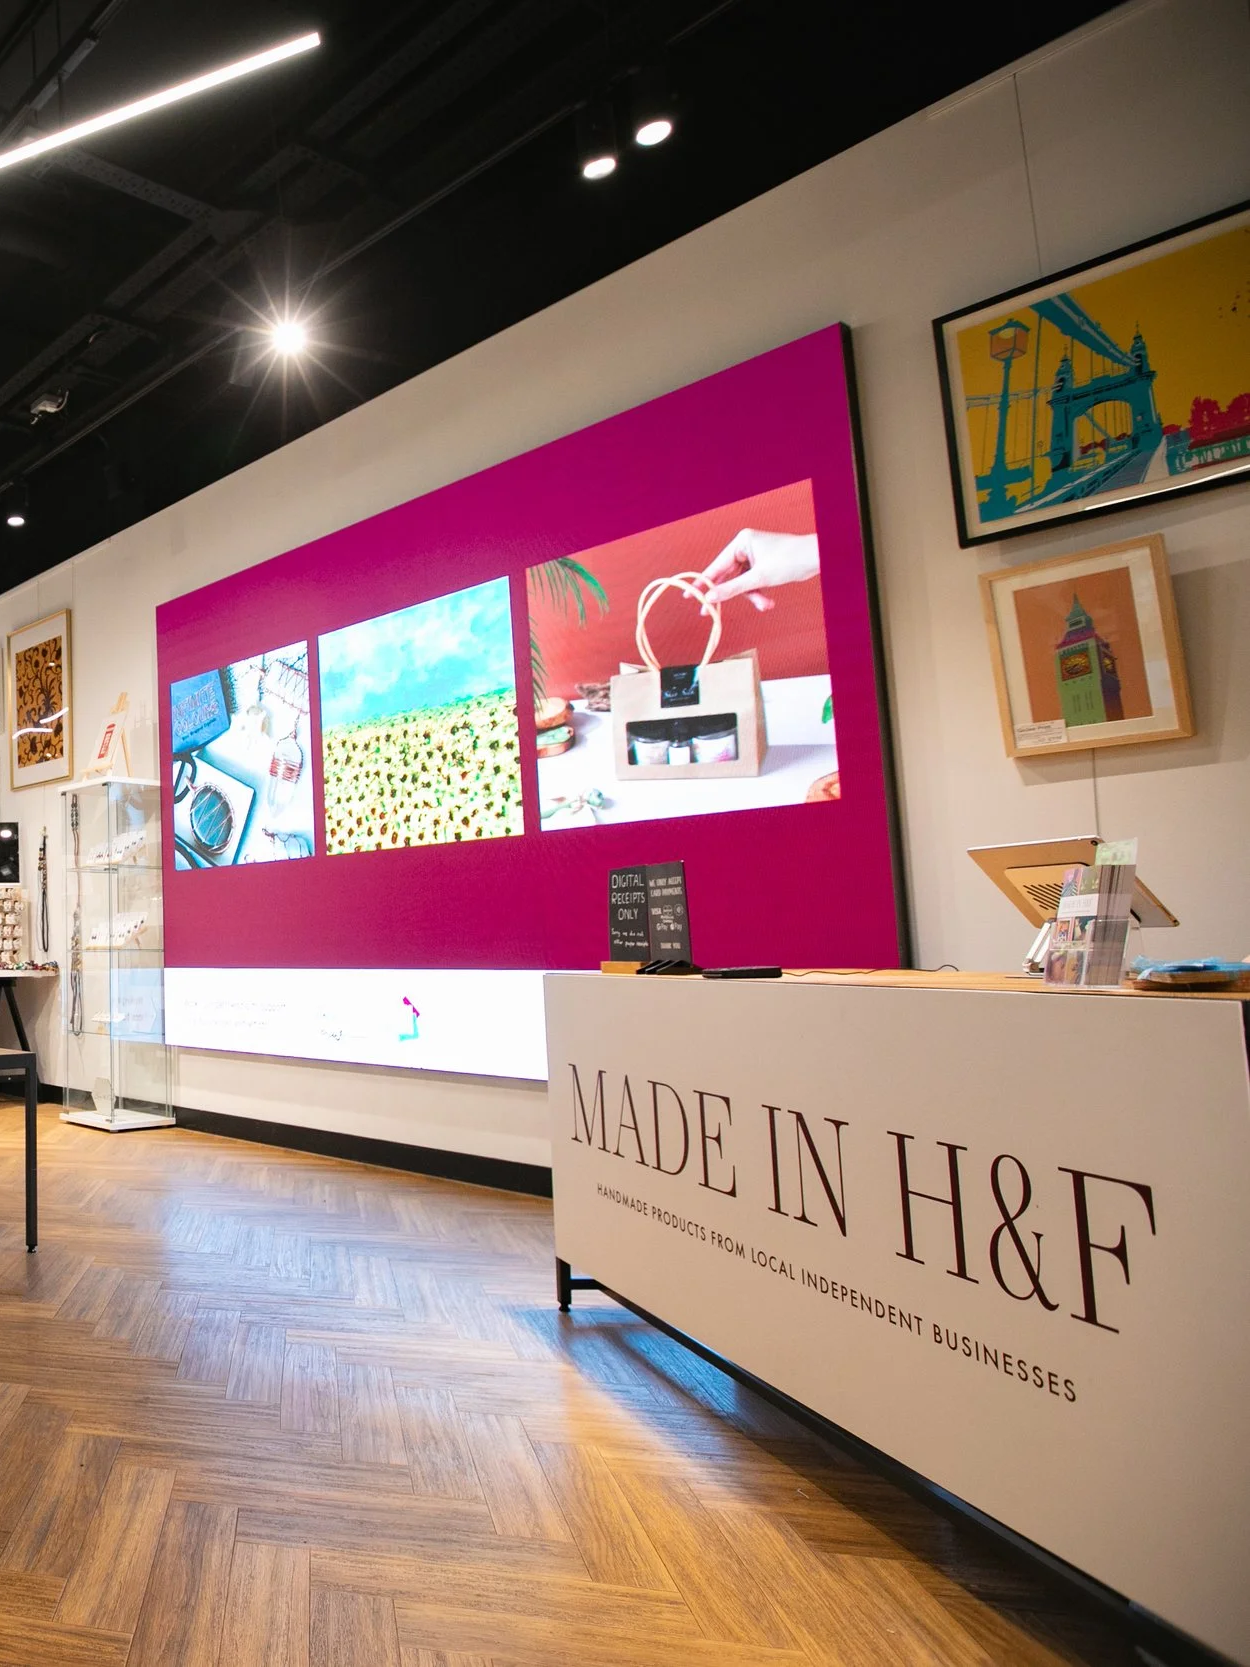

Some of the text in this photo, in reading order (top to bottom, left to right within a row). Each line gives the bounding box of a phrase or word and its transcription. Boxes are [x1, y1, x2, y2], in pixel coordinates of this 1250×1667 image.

[611, 874, 644, 889] DIGITAL
[611, 891, 646, 905] RECEIPTS
[617, 908, 638, 920] ONLY
[568, 1063, 1157, 1335] MADE IN H&F
[597, 1183, 1077, 1403] HANDMADE PRODUCTS FROM LOCAL INDEPENDENT BUSINESSES
